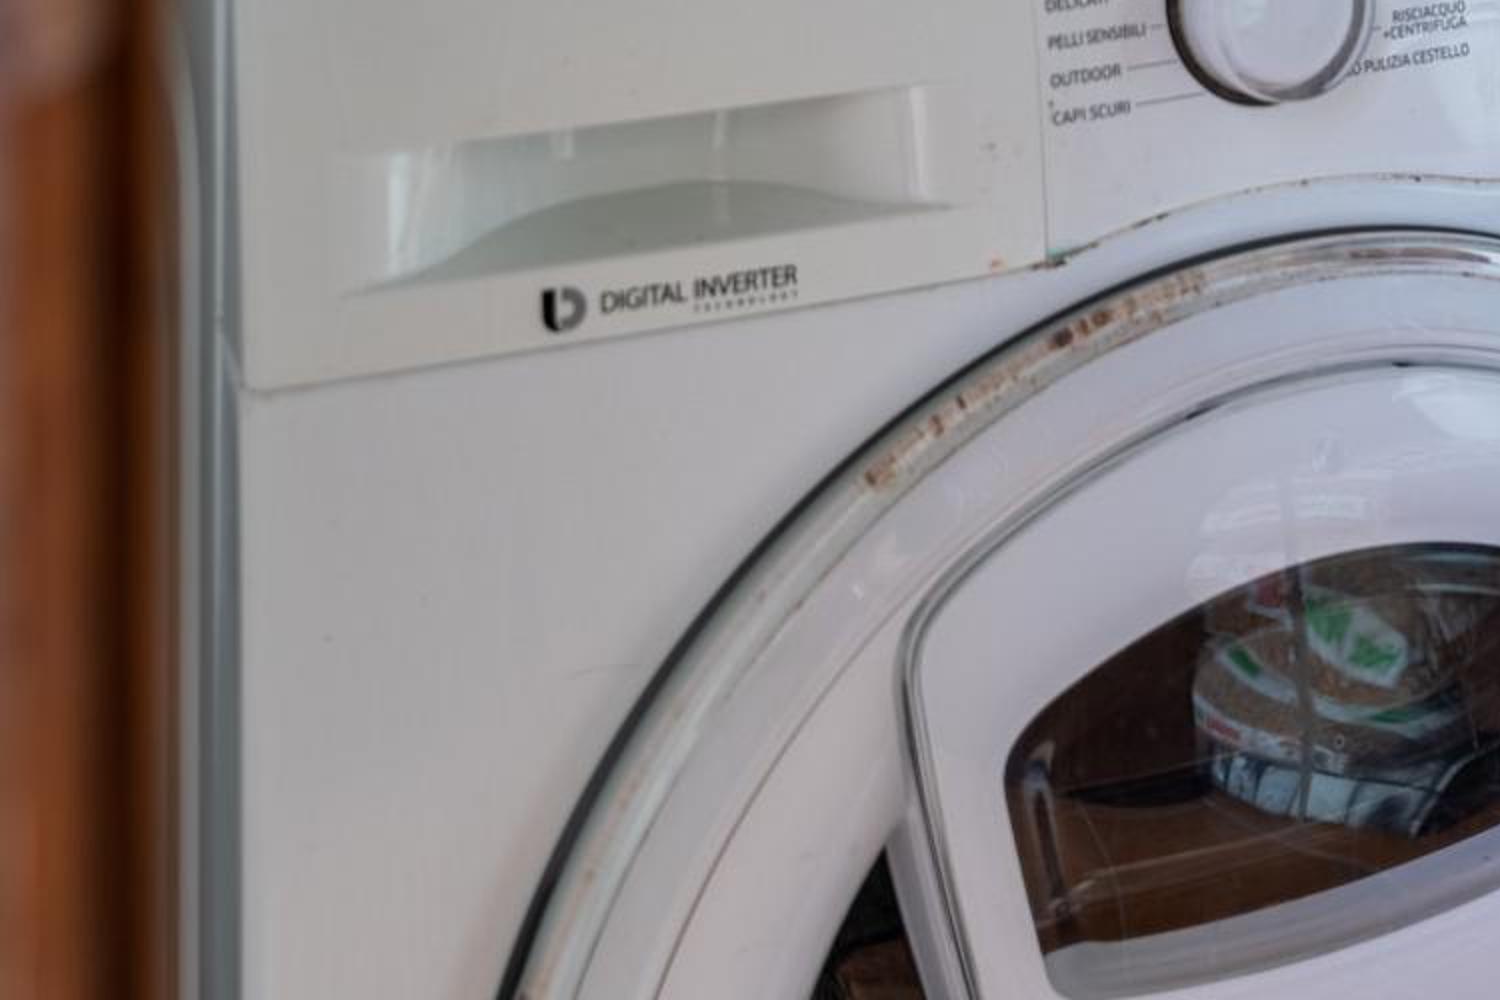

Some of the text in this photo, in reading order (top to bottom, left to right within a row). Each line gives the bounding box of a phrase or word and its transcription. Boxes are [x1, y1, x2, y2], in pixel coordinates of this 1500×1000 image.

[1392, 0, 1466, 22] RISCIACQUO
[1048, 23, 1147, 50] PELLI SENSIBILI
[1363, 42, 1470, 73] PULIZIA CESTELLO
[1051, 63, 1121, 88] OUTDOOR
[1053, 101, 1131, 126] CAPI SCURI
[601, 281, 687, 314] DIGITAL
[693, 263, 798, 299] INVERTER
